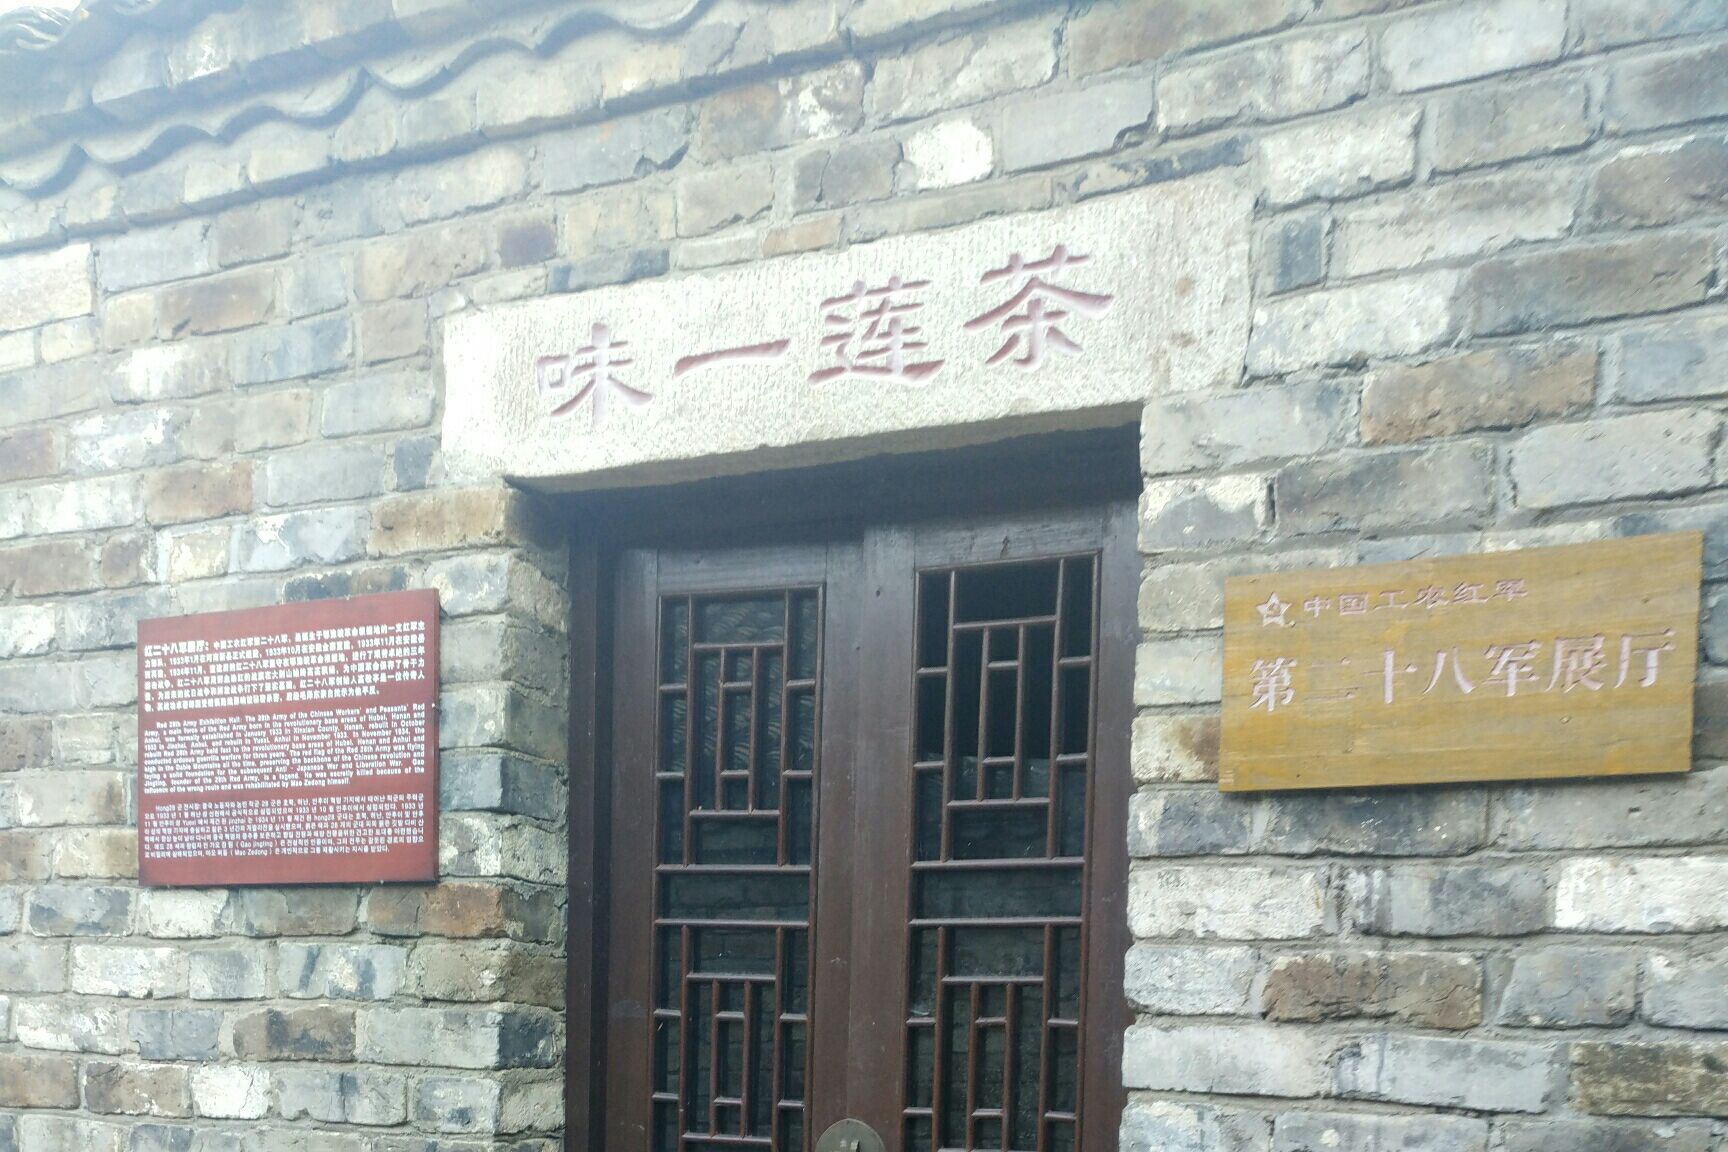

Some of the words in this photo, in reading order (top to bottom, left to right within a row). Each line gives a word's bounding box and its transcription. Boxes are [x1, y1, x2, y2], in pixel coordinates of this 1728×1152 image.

[1248, 628, 1677, 712] 第二十八军展厅
